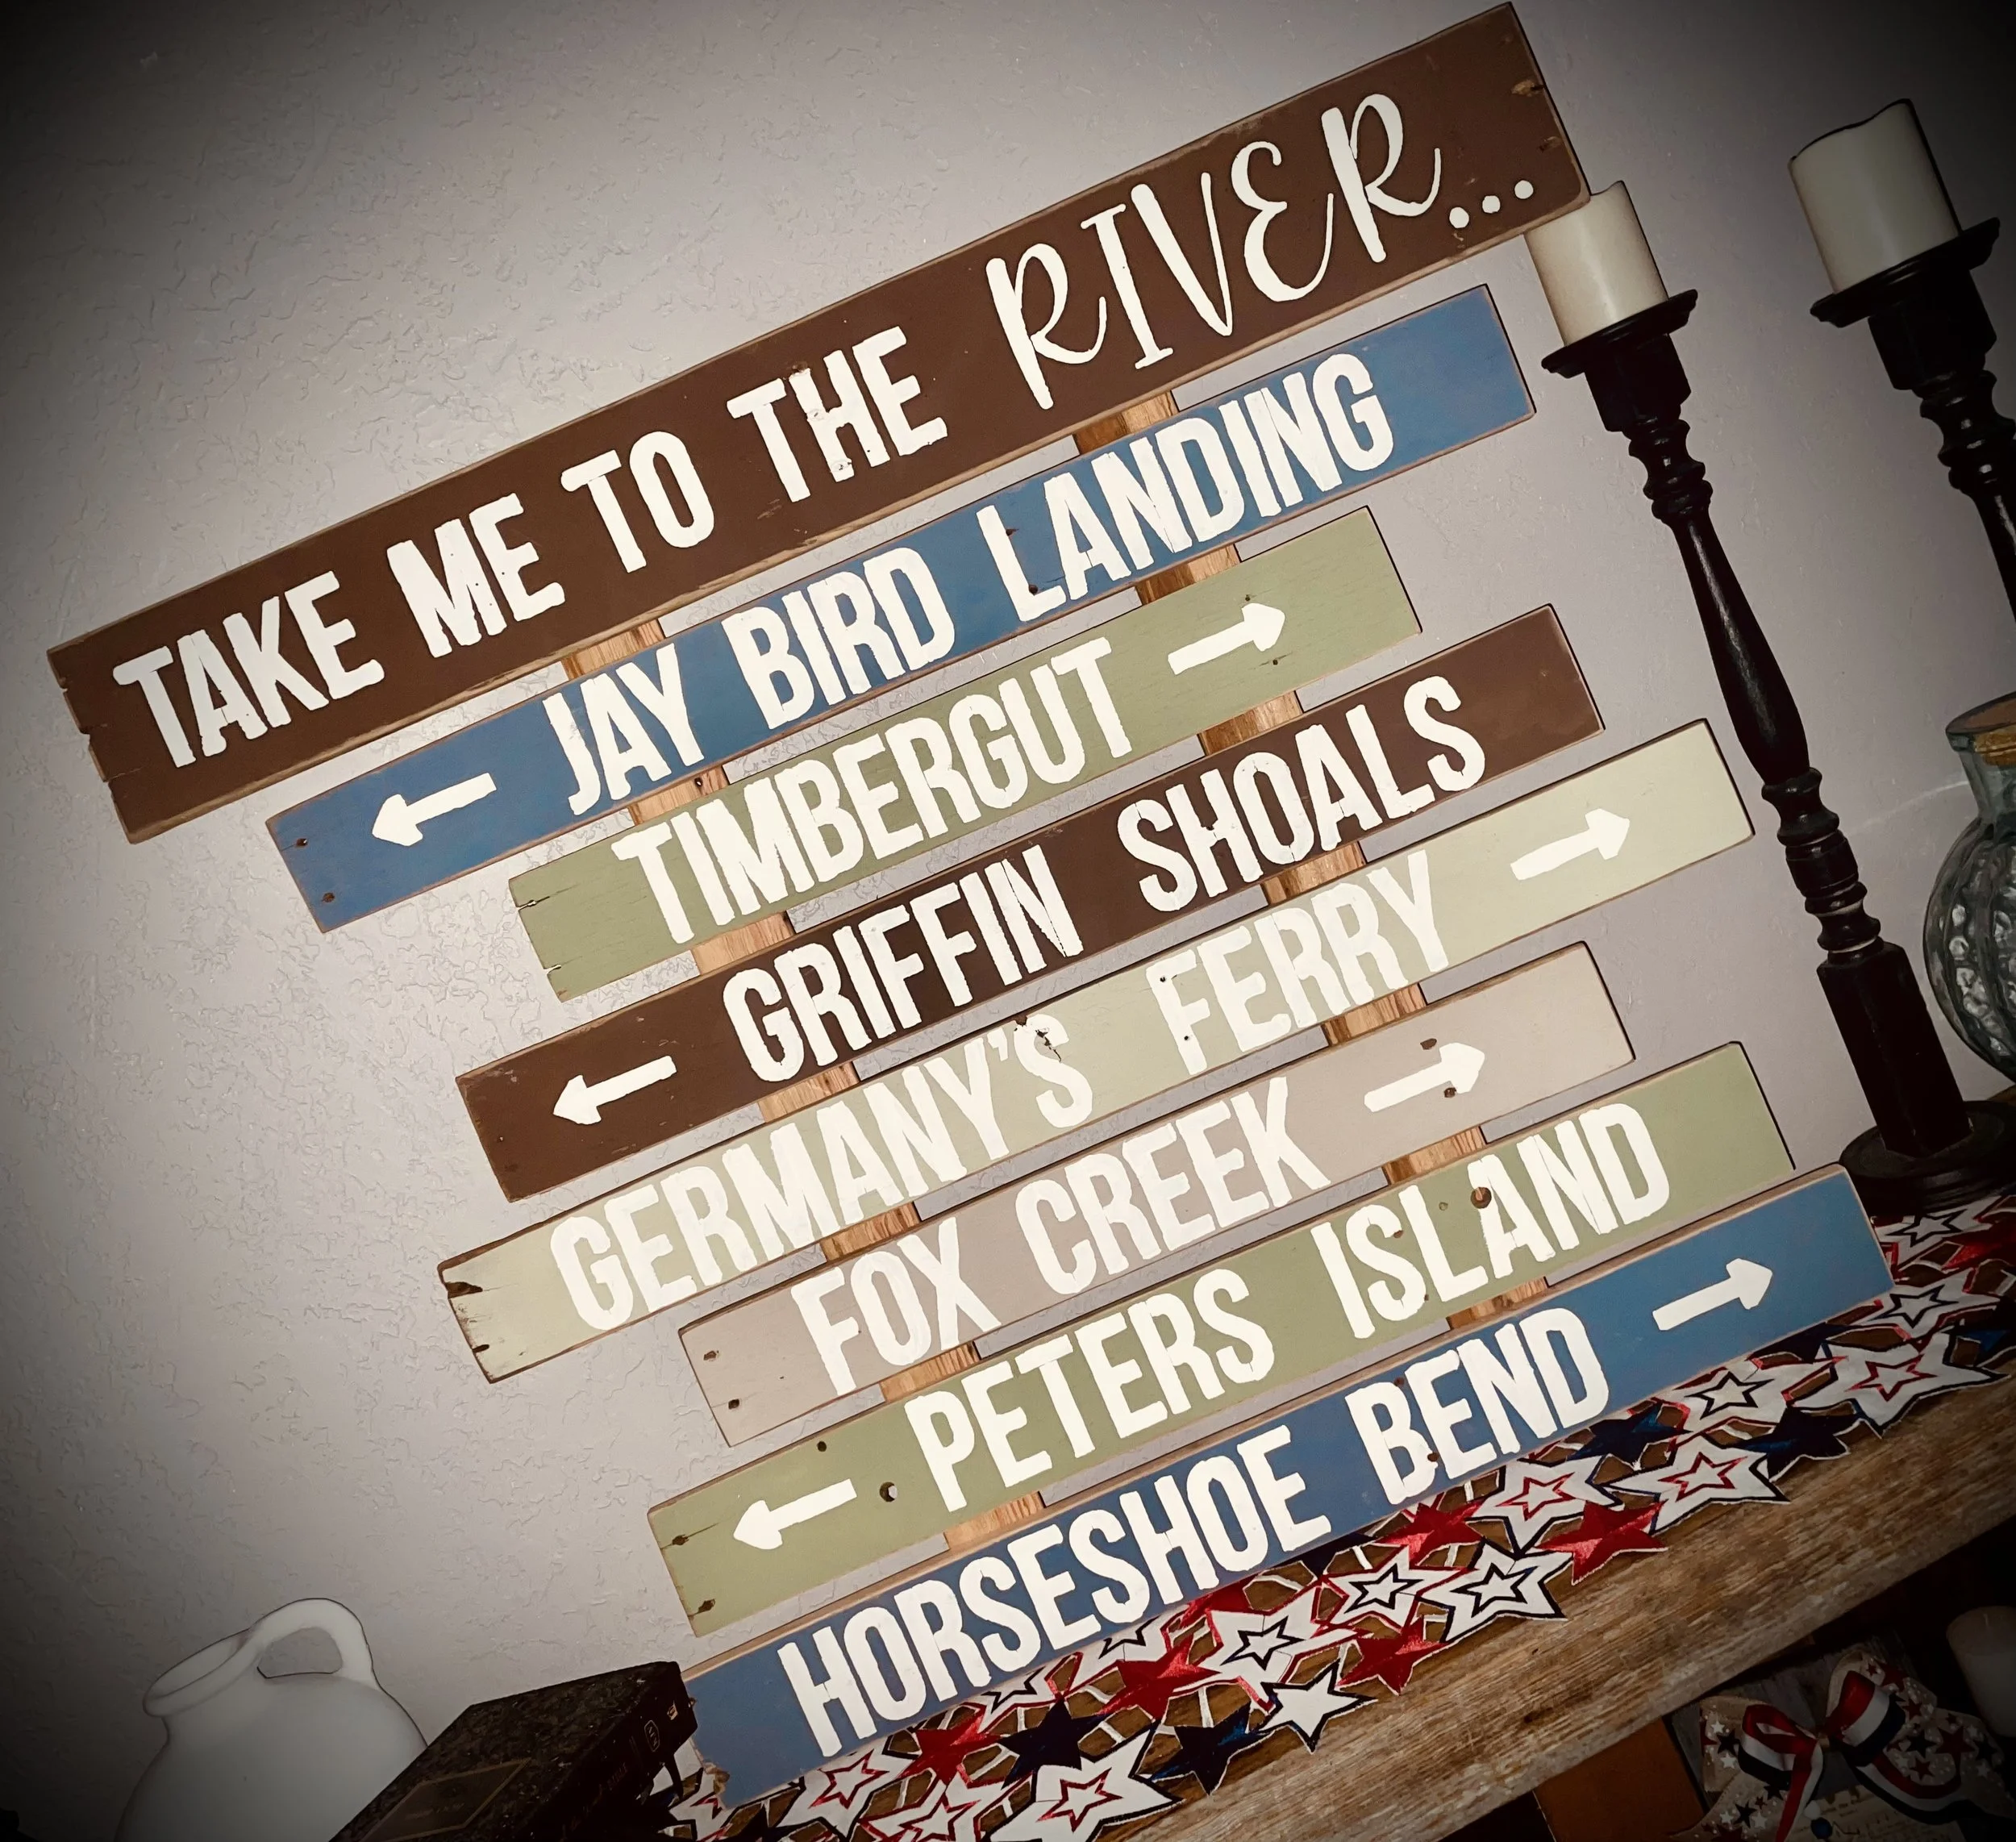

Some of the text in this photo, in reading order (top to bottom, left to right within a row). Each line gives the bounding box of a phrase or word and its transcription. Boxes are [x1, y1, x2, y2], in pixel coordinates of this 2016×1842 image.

[113, 571, 385, 768] TAKE
[386, 493, 564, 658] ME
[560, 431, 714, 573] TO
[727, 326, 947, 503] THE
[542, 352, 1393, 816] JAY BIRD LANDING
[610, 636, 1132, 945] TIMBERGUT
[722, 676, 1485, 1083] GRIFFIN SHOALS
[550, 850, 1449, 1331] GERMANY'S FERRY
[790, 1076, 1331, 1398] FOX CREEK
[904, 1102, 1669, 1513] PETERS ISLAND
[777, 1307, 1610, 1758] HORSESHOE BEND
